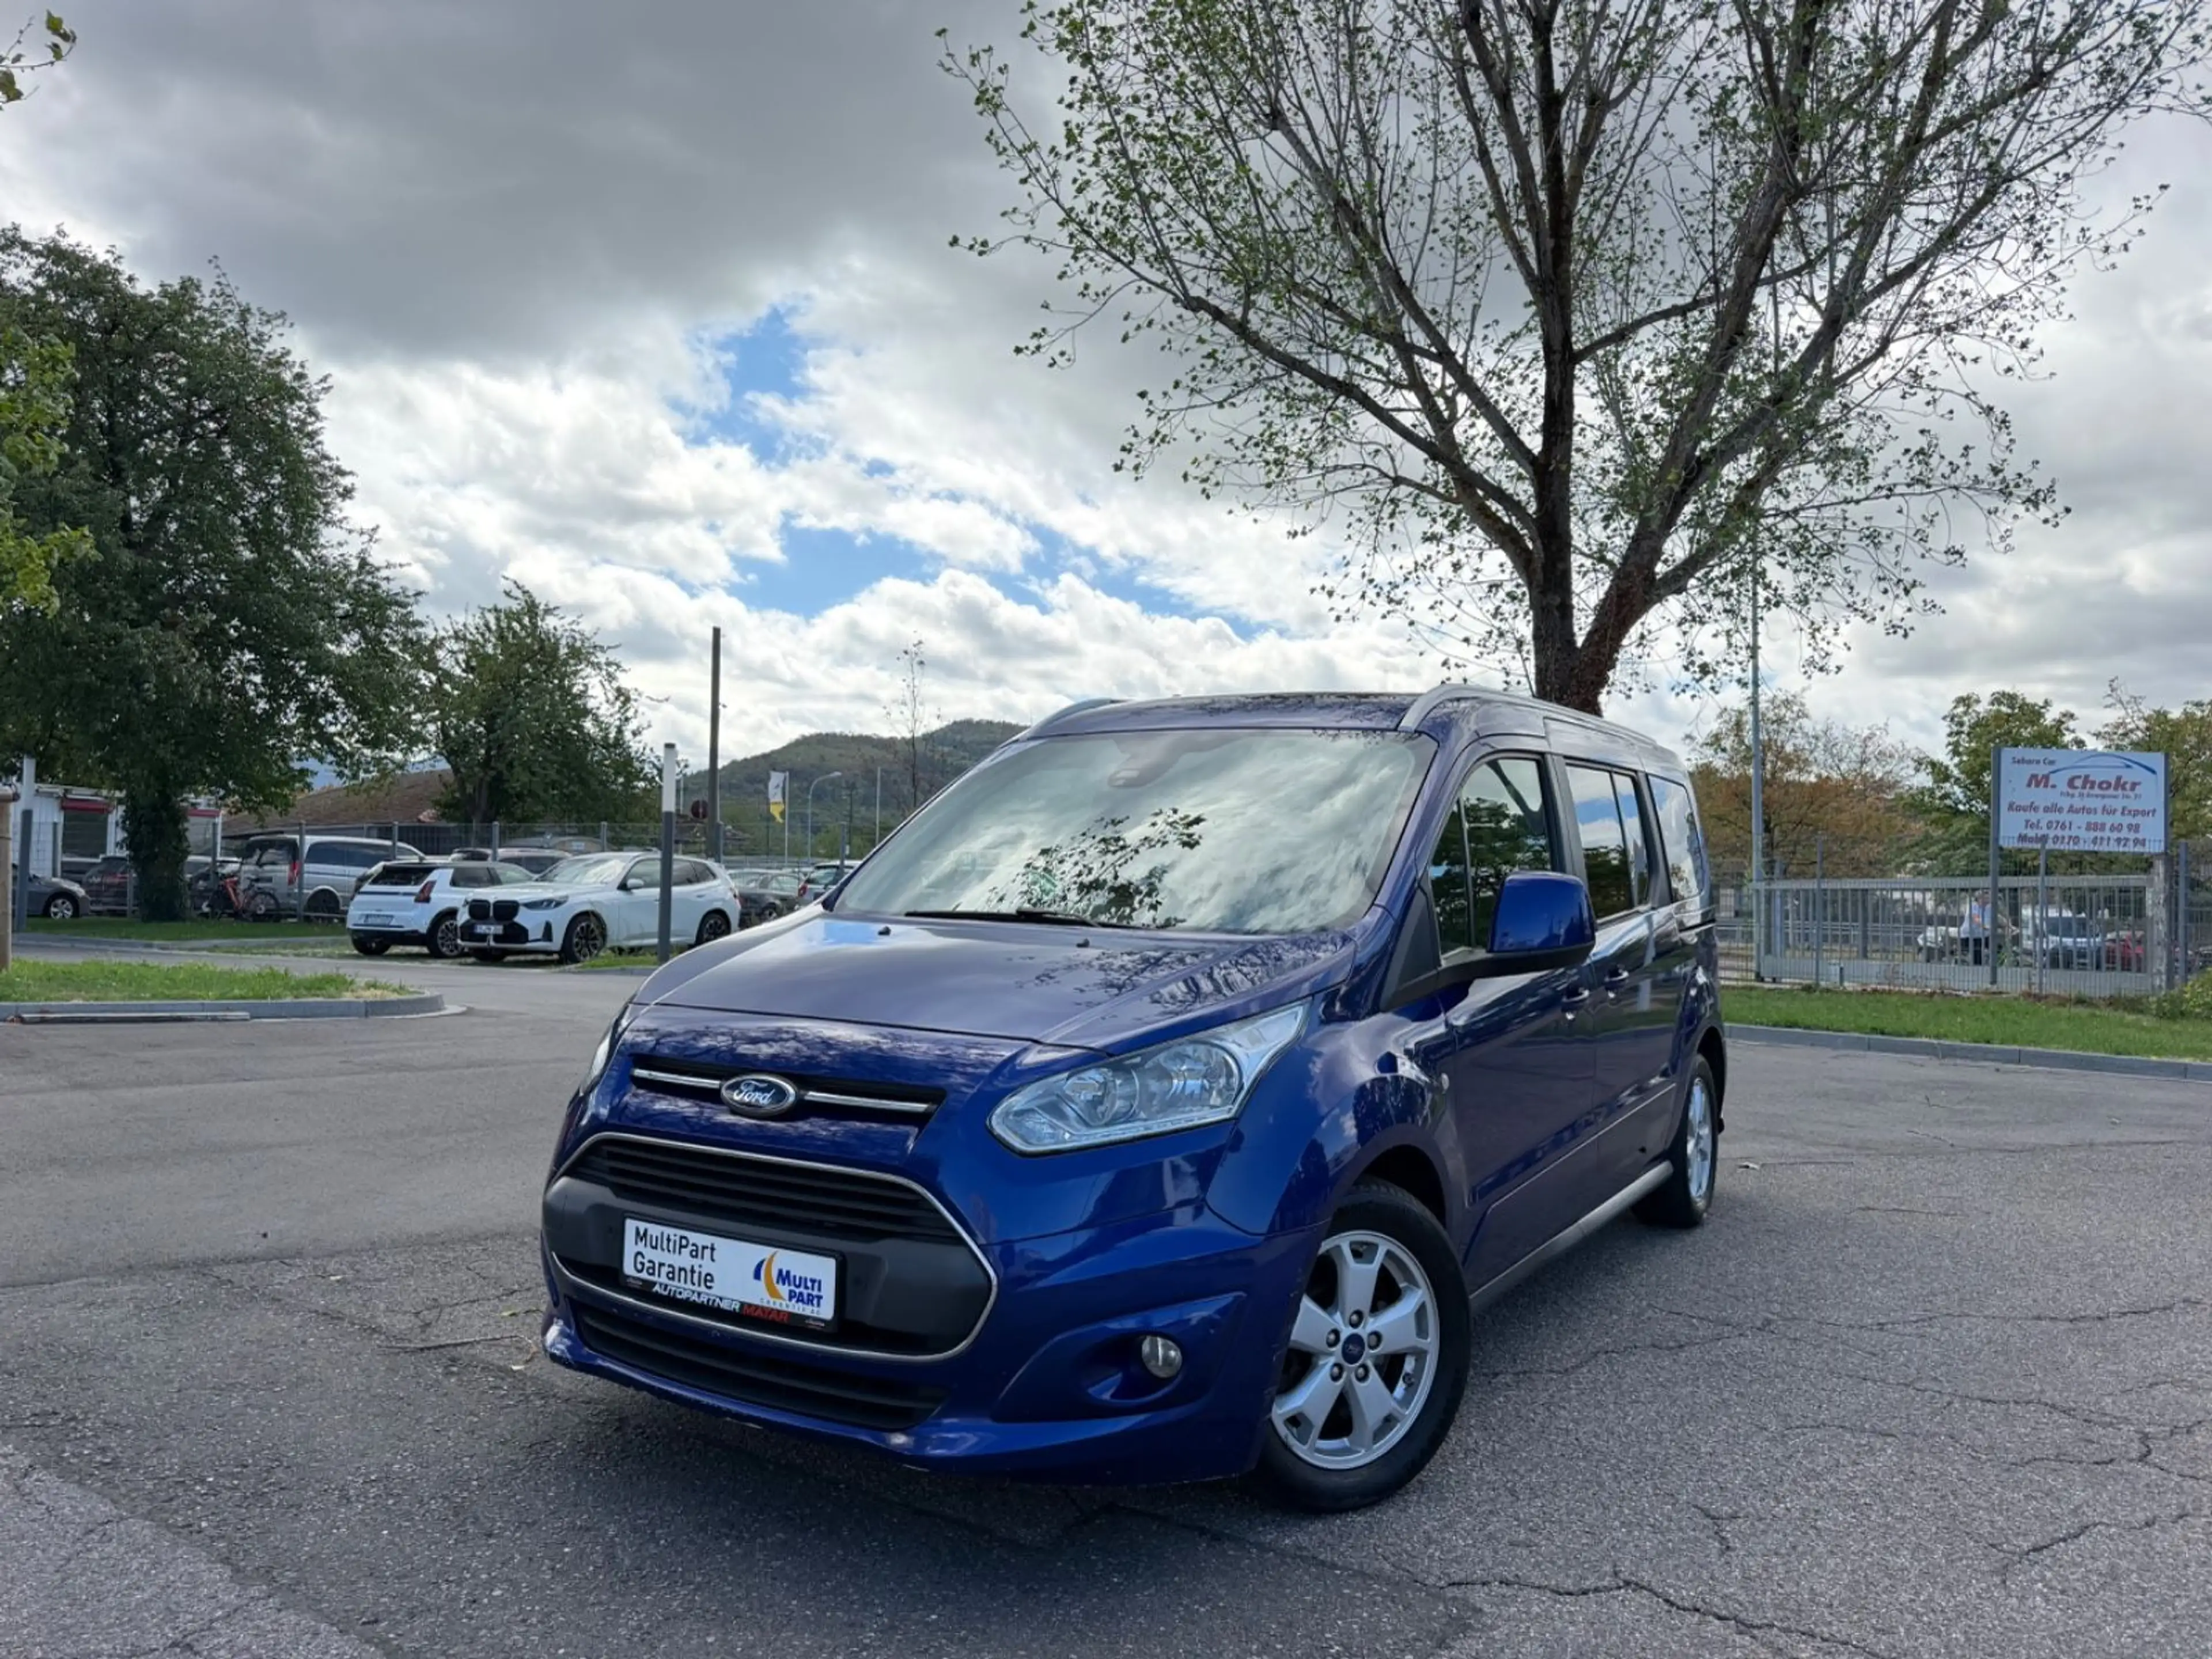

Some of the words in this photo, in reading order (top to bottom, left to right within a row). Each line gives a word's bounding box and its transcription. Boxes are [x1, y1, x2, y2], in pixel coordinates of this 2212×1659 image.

[2026, 774, 2057, 788] M.
[2067, 774, 2142, 791] Chokr
[2007, 801, 2039, 813] Kaufe
[2043, 802, 2064, 815] alle
[2066, 803, 2097, 815] Autos
[2101, 804, 2118, 816] für
[2121, 805, 2157, 818] Export
[2024, 819, 2043, 830] Tel.
[2046, 819, 2072, 831] 0761
[2109, 822, 2123, 833] 60
[2126, 823, 2141, 834] 98
[733, 1080, 775, 1104] Ford
[635, 1225, 716, 1262] MultiPart
[634, 1251, 714, 1290] Garantie
[652, 1282, 741, 1312] AUTOPARTNER
[788, 1289, 823, 1308] PART
